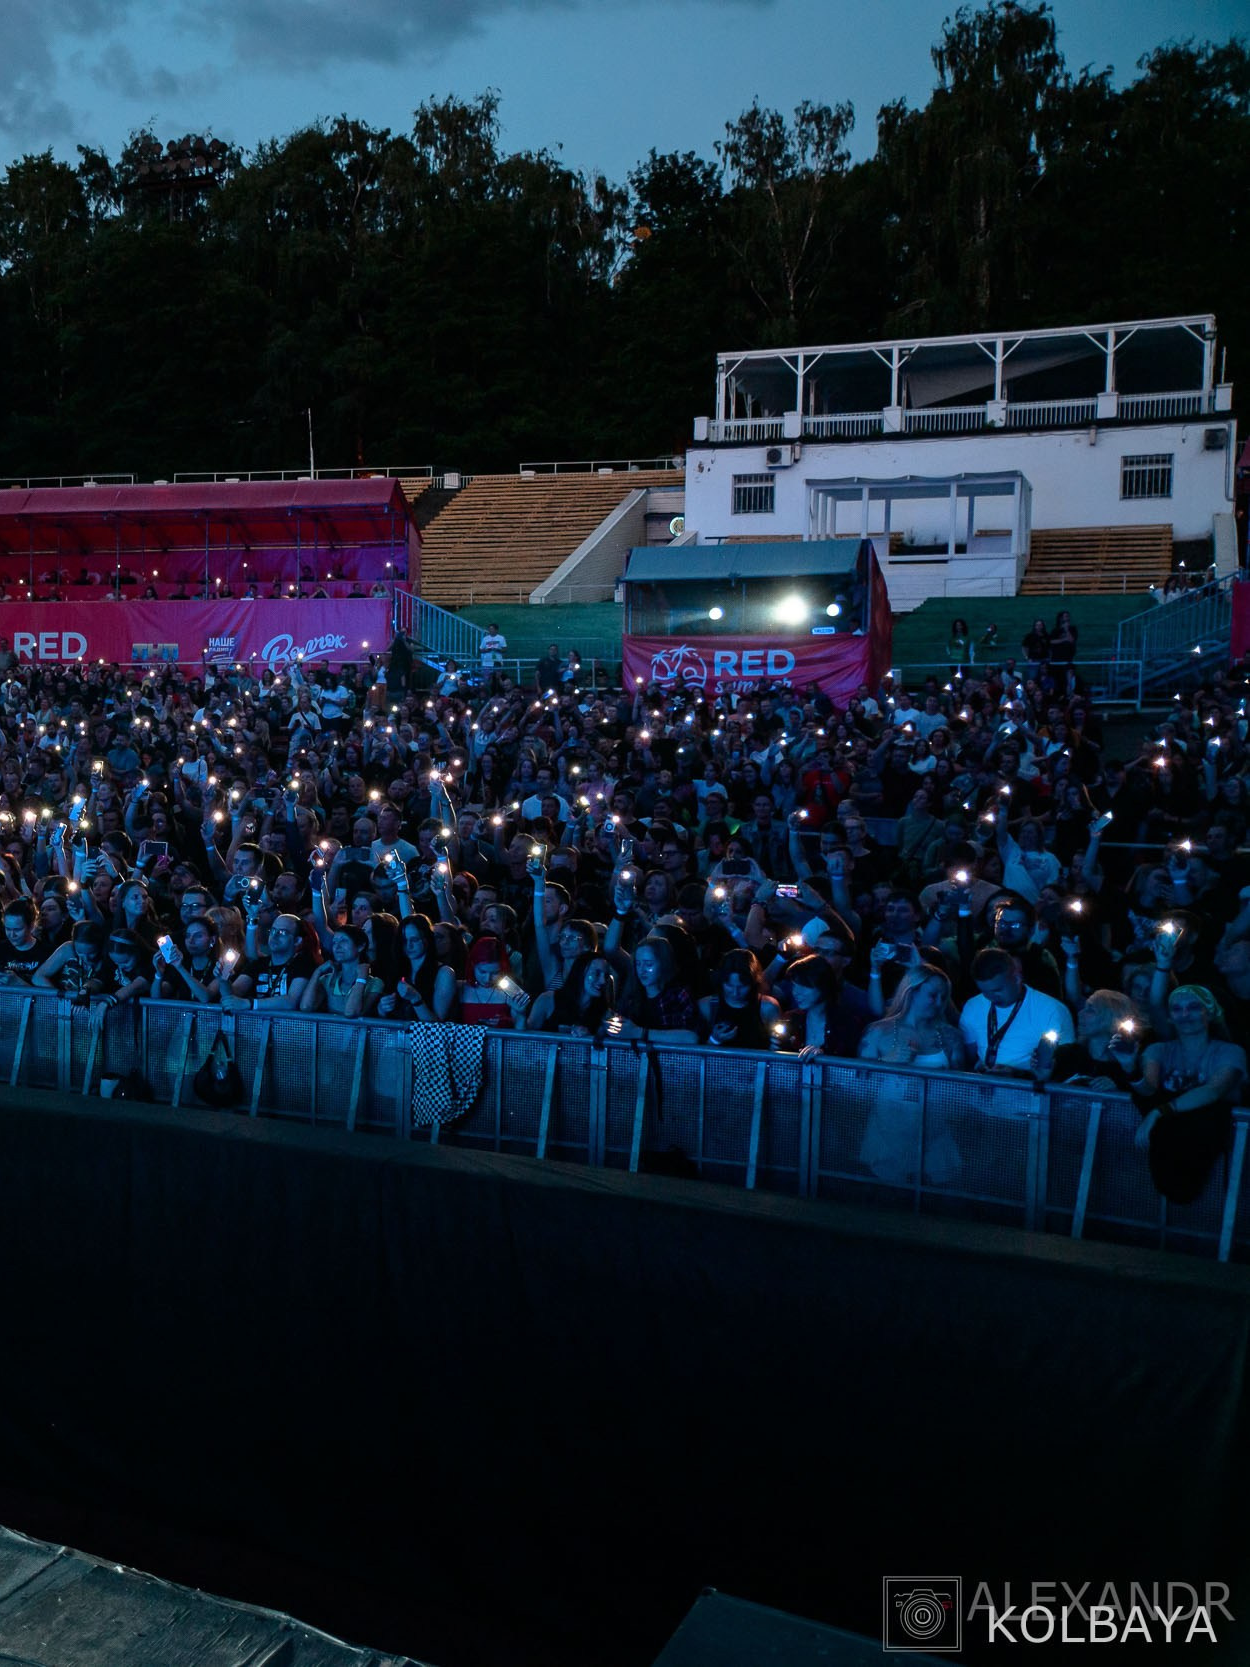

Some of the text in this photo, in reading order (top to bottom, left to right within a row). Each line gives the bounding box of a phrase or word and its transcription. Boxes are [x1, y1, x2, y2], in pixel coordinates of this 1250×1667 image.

[14, 632, 88, 660] RED
[209, 637, 235, 647] НАШЕ
[714, 649, 796, 677] RED
